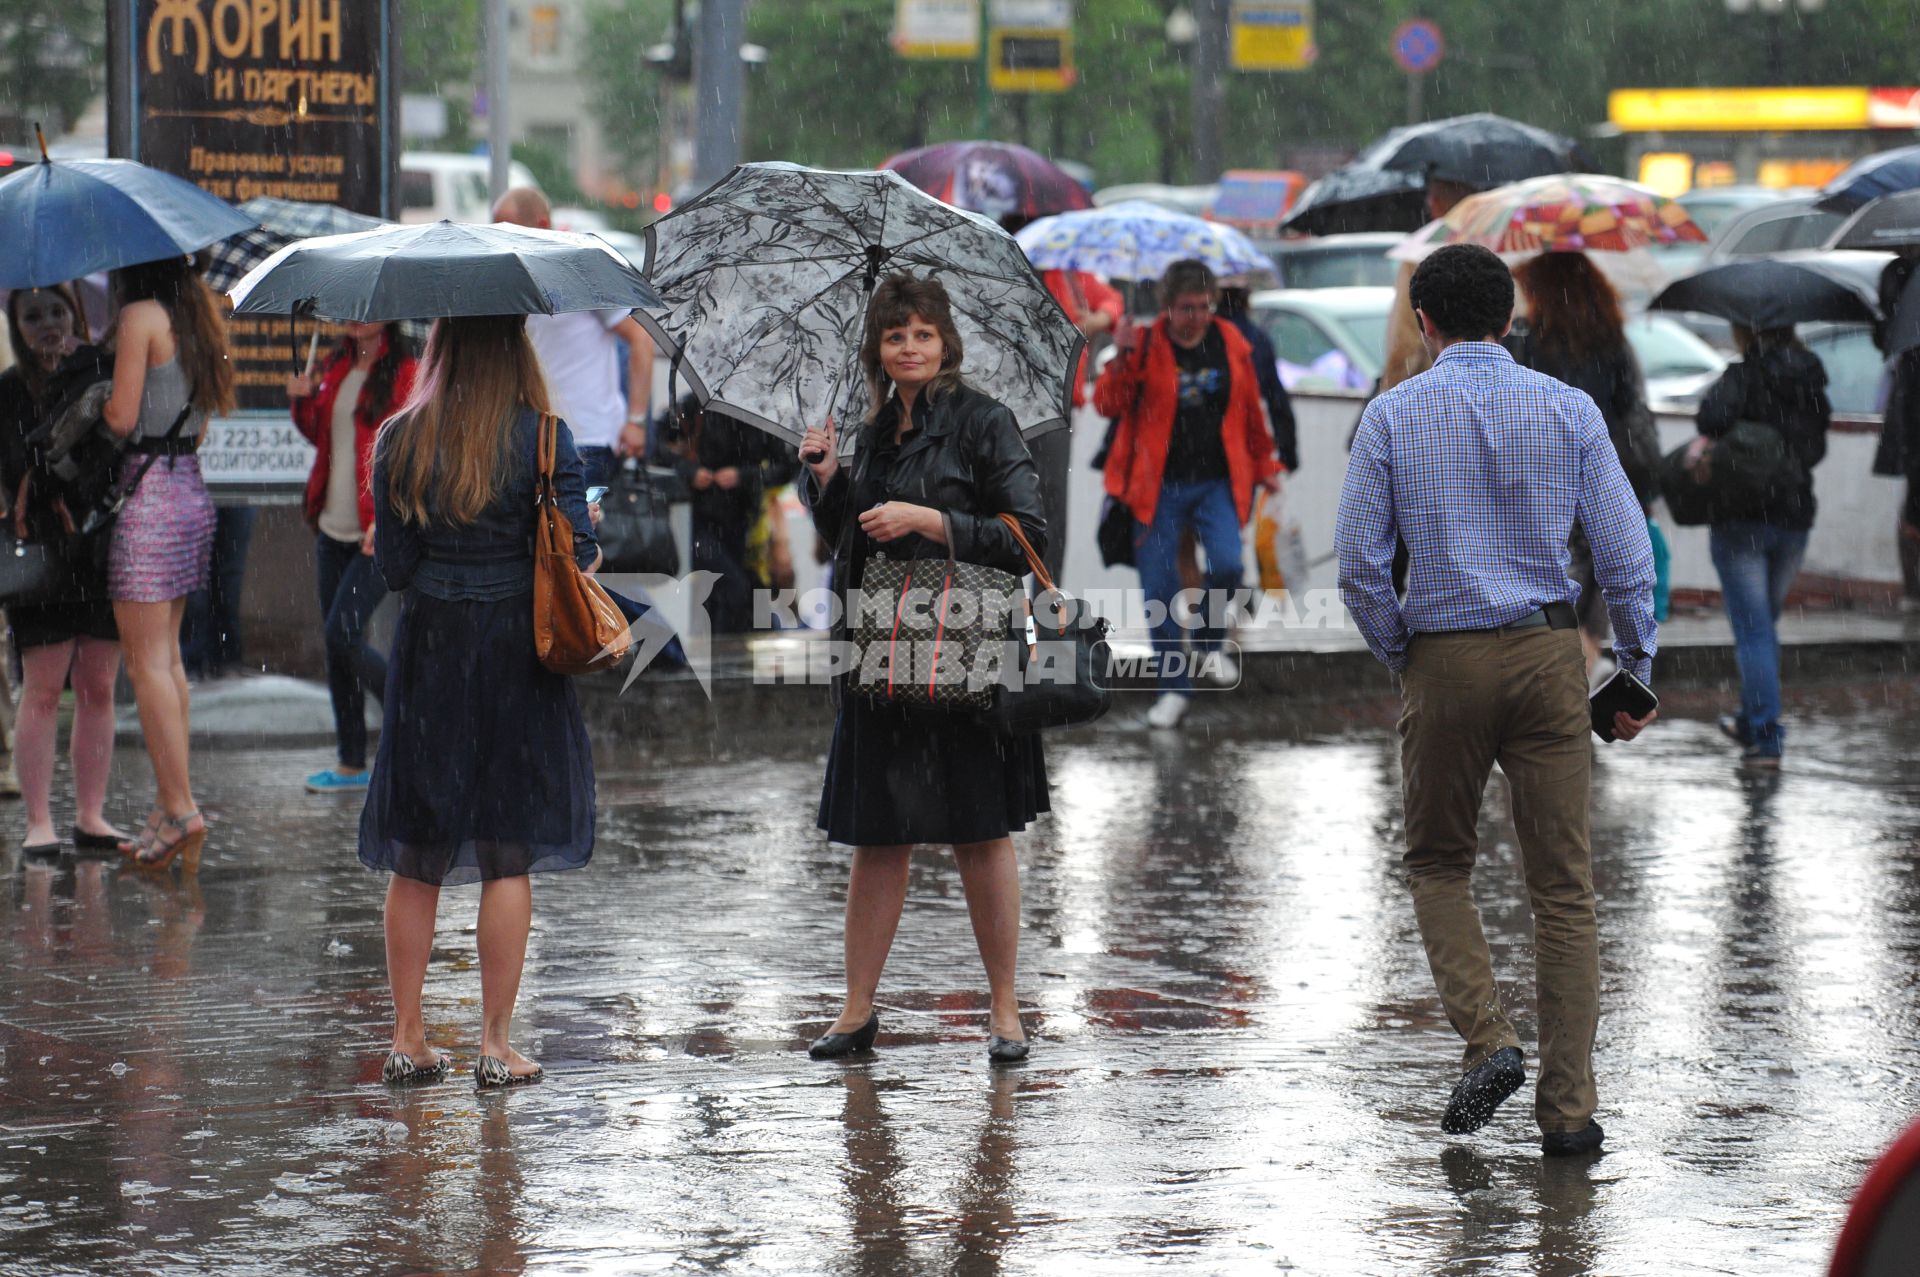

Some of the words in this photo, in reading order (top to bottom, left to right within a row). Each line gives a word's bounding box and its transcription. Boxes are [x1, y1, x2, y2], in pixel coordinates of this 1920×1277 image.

[213, 67, 235, 100] И
[243, 69, 376, 105] ПАРТНЕРЫ
[190, 147, 284, 176] Правовые
[288, 154, 344, 177] услуги
